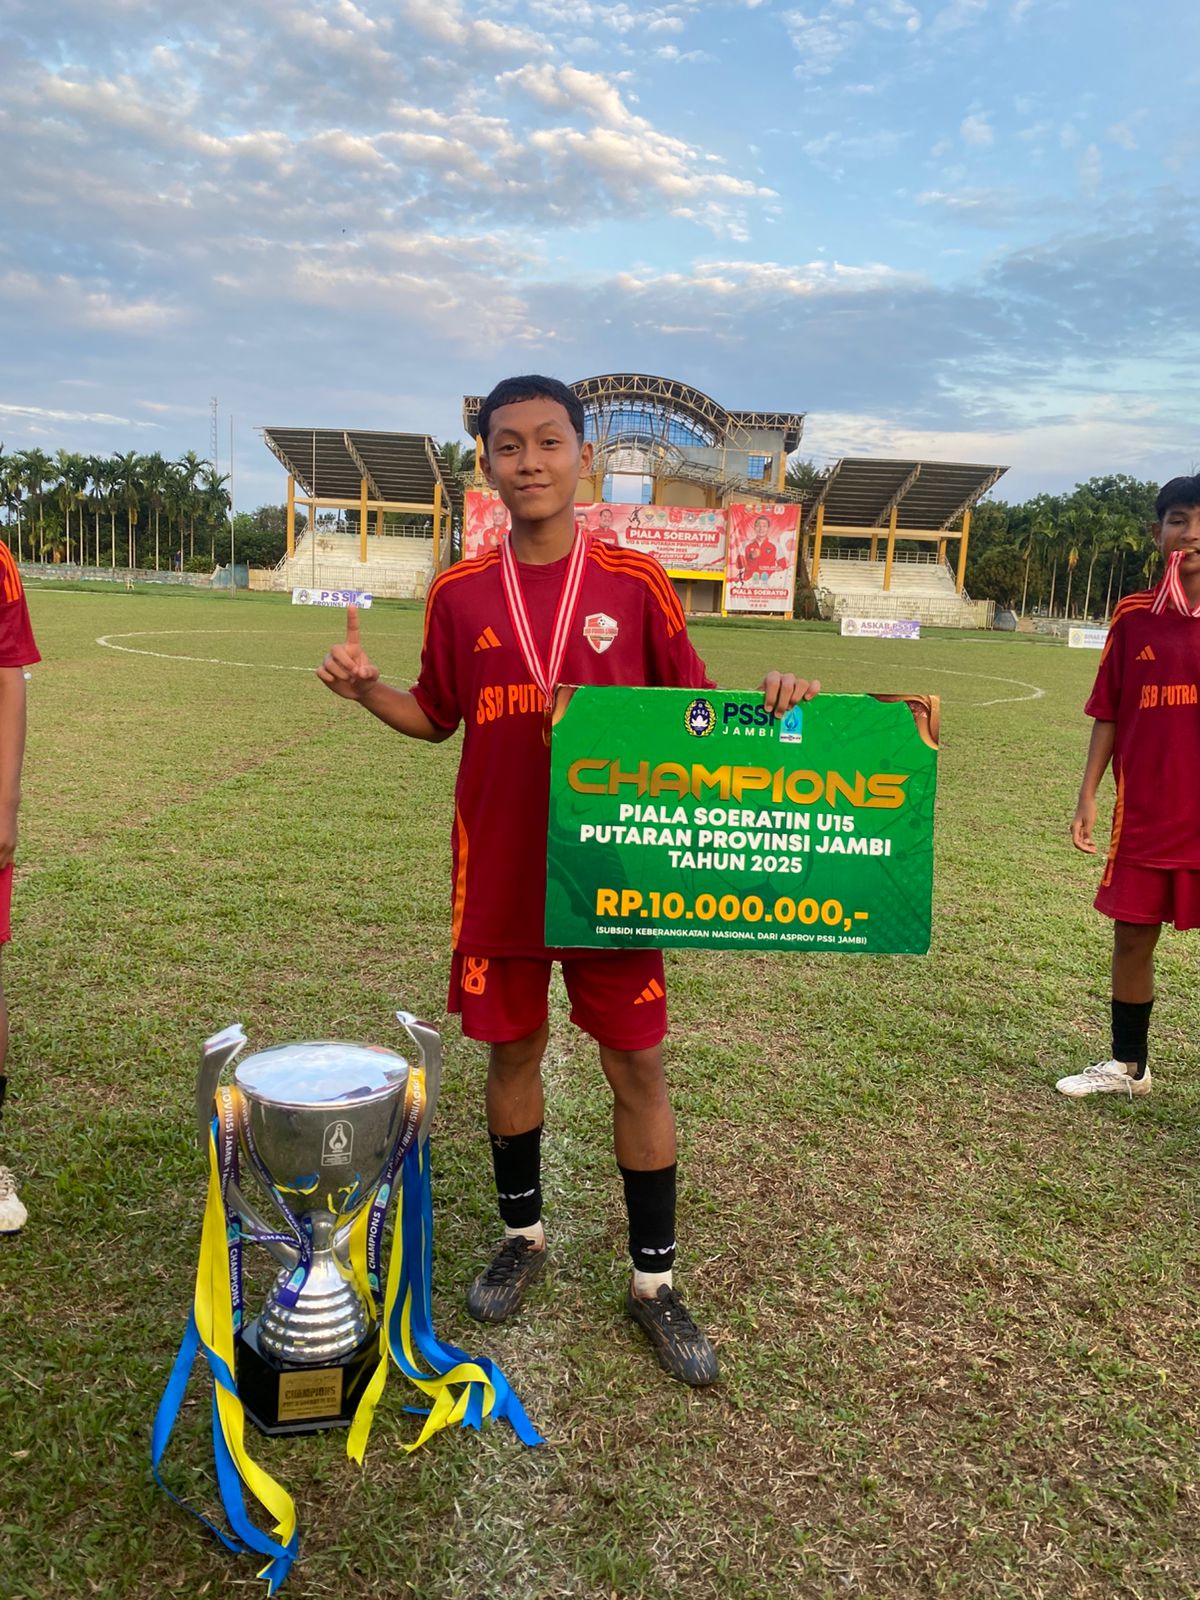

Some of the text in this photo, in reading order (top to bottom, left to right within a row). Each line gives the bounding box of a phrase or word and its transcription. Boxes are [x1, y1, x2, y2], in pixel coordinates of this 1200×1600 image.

[629, 529, 716, 542] PIALA SOERATIN
[321, 591, 357, 602] PSSI
[861, 621, 890, 630] ASKAB
[1160, 684, 1198, 706] PUTRA
[722, 702, 776, 726] PSSI
[722, 726, 774, 737] JAMBI
[566, 757, 911, 809] CHAMPIONS
[619, 803, 855, 833] PIALA SOERATIN U15
[580, 824, 892, 857] PUTARAN PROVINSI JAMBI
[667, 850, 803, 874] TAHUN 2025
[595, 887, 869, 932] RP.10.000.000,-
[595, 925, 868, 945] (SUBSIDI KEBERANGKATAN NASIONAL DARI ASPROV PSSI JAMBI)
[221, 1086, 234, 1133] ROVINSI
[409, 1078, 421, 1123] PROVINSI
[224, 1135, 234, 1167] JAMBI
[368, 1211, 381, 1270] CHAMPIONS
[229, 1248, 240, 1306] CHAMPIONS
